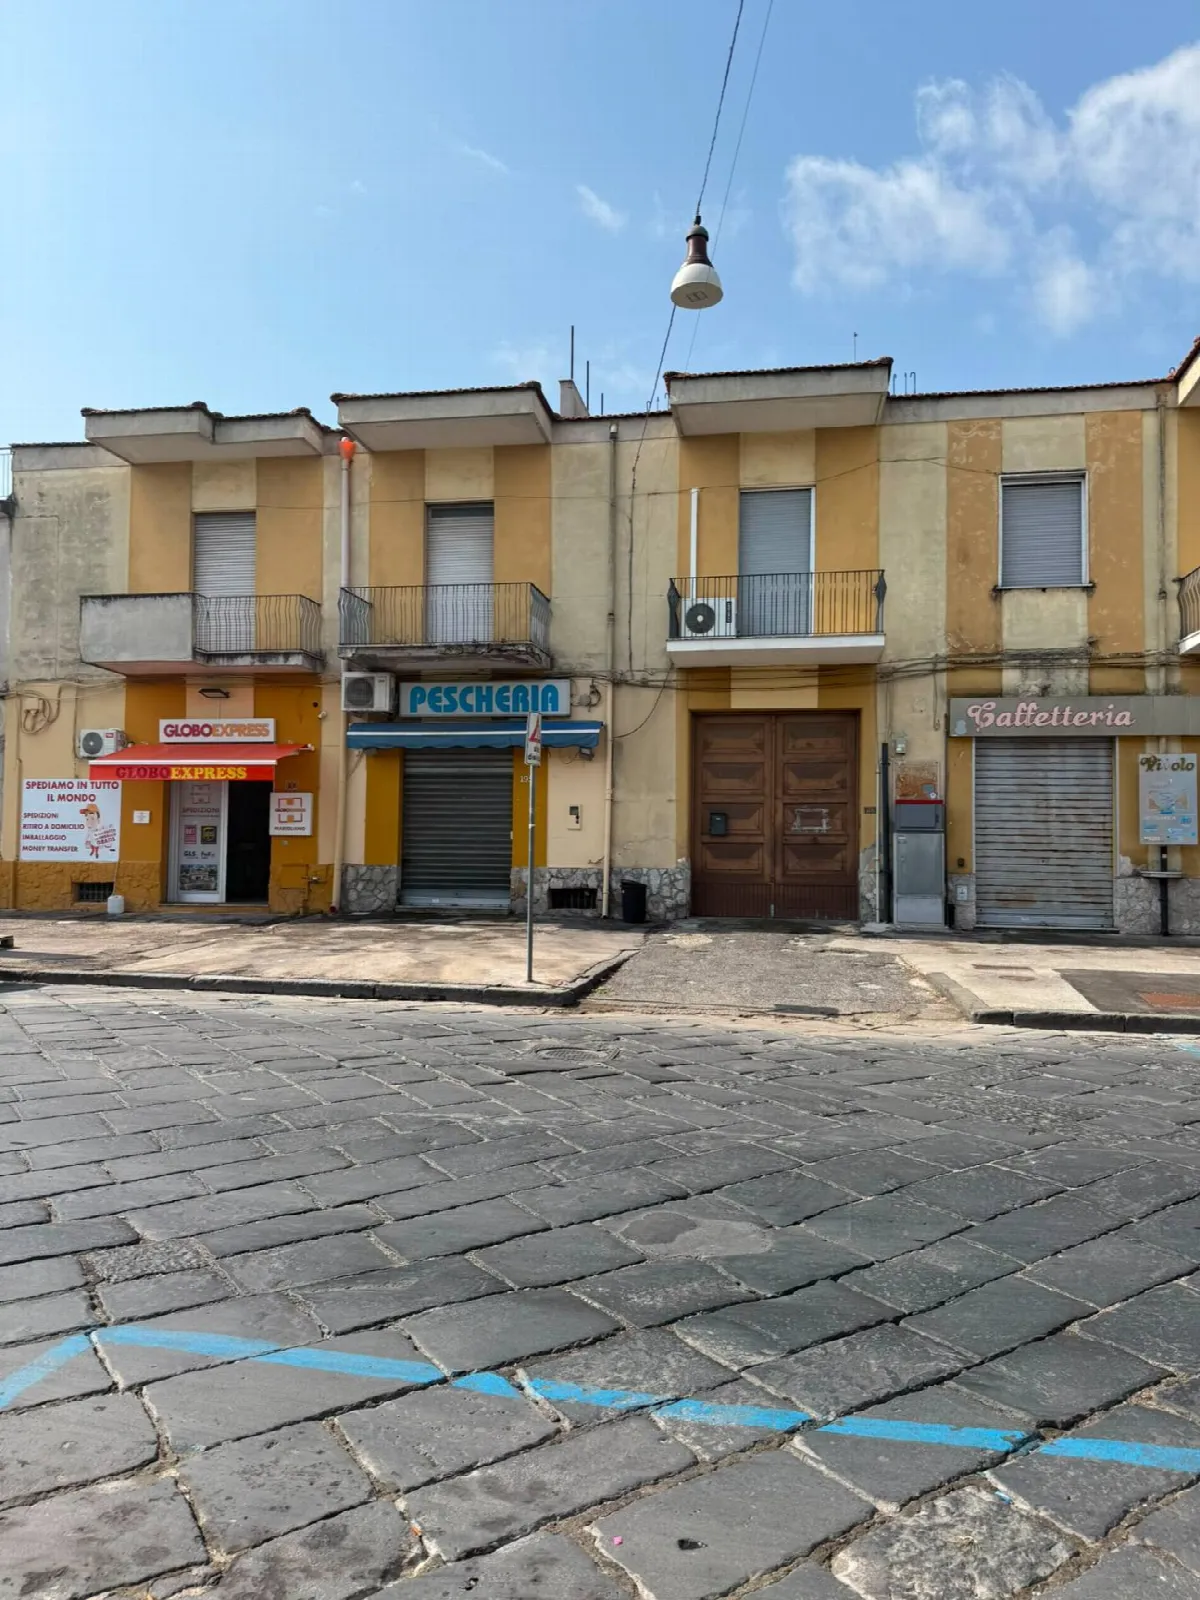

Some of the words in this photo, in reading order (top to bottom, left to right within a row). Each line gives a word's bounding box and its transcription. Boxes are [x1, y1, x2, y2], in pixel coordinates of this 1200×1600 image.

[409, 683, 559, 713] PESCHERIA
[966, 702, 1136, 732] Caffetteria
[25, 781, 74, 790] SPEDIAMO
[77, 781, 88, 790] IN
[90, 781, 120, 790] TUTTO
[47, 793, 55, 802] IL
[57, 793, 97, 802] MONDO
